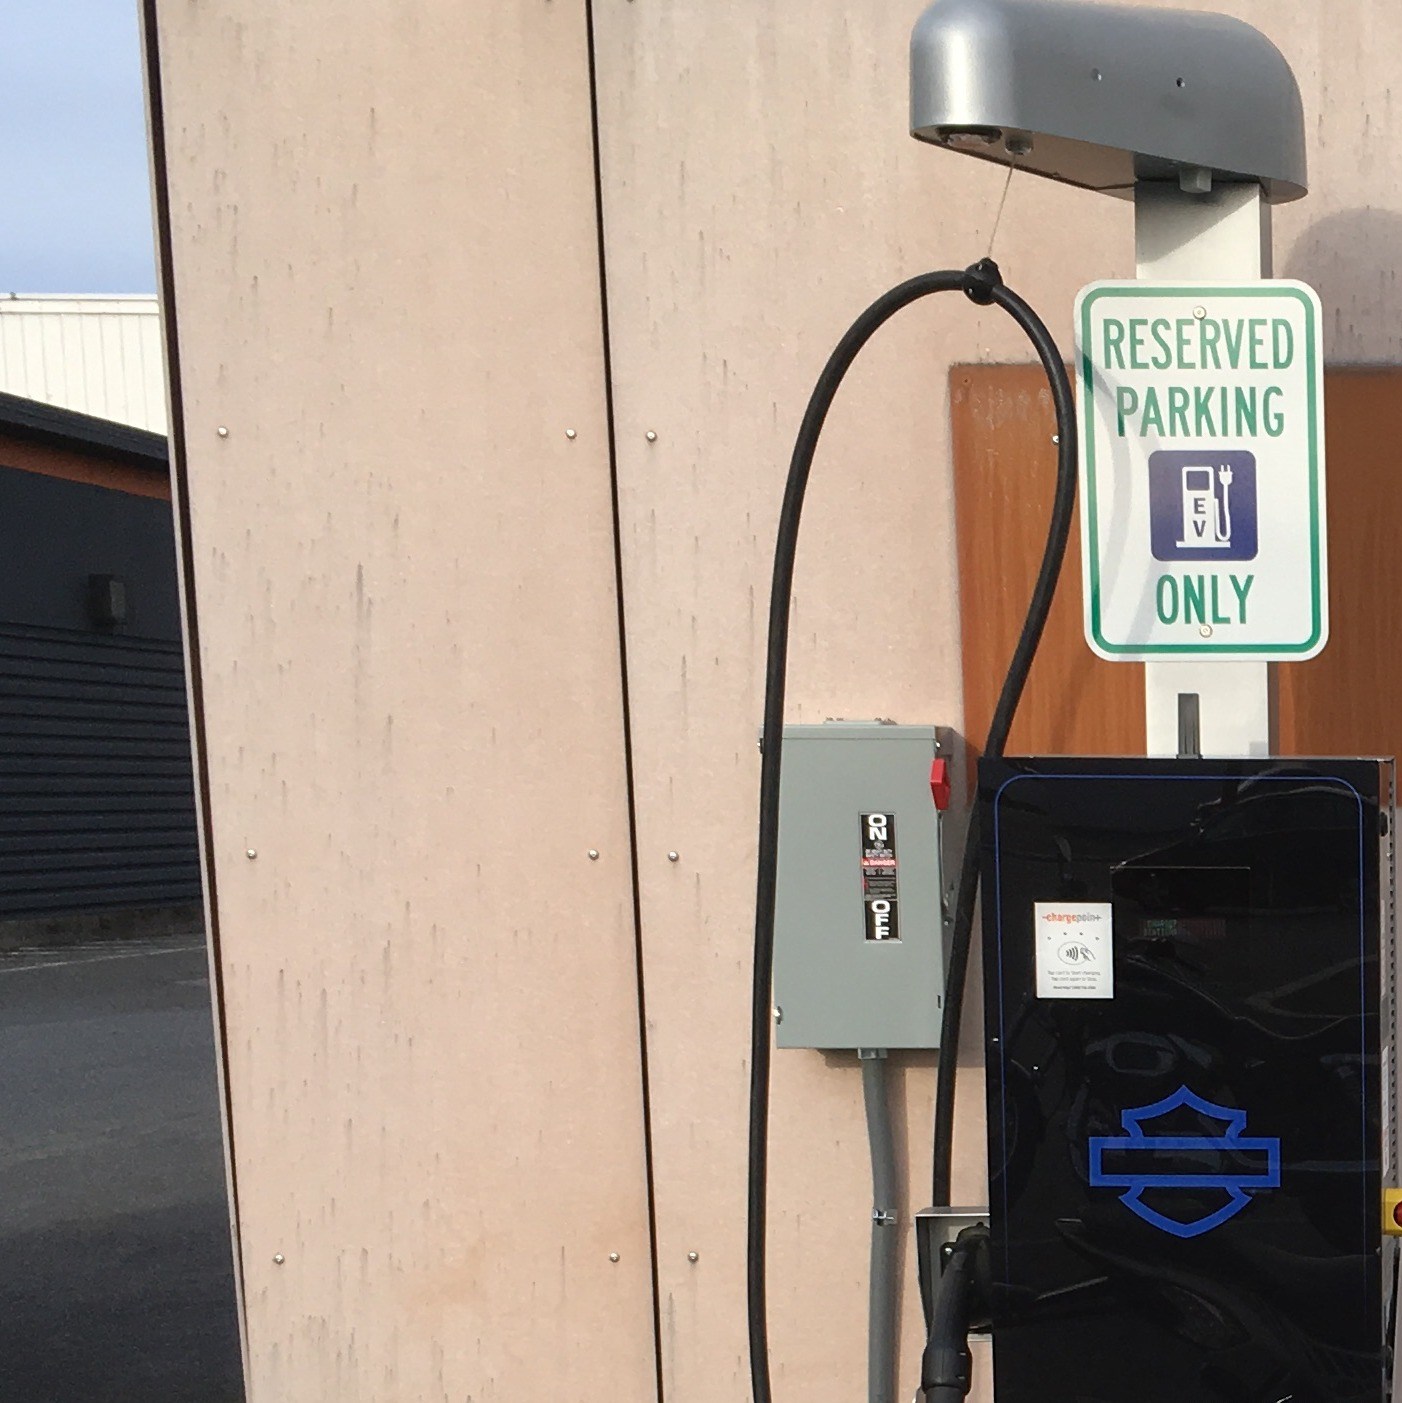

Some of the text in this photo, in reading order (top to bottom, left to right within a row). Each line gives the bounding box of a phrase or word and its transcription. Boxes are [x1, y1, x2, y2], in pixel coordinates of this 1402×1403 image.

[1103, 318, 1294, 370] RESERVED
[1116, 386, 1285, 437] PARKING
[1156, 574, 1255, 625] ONLY
[868, 814, 887, 841] ON
[871, 900, 891, 940] OFF
